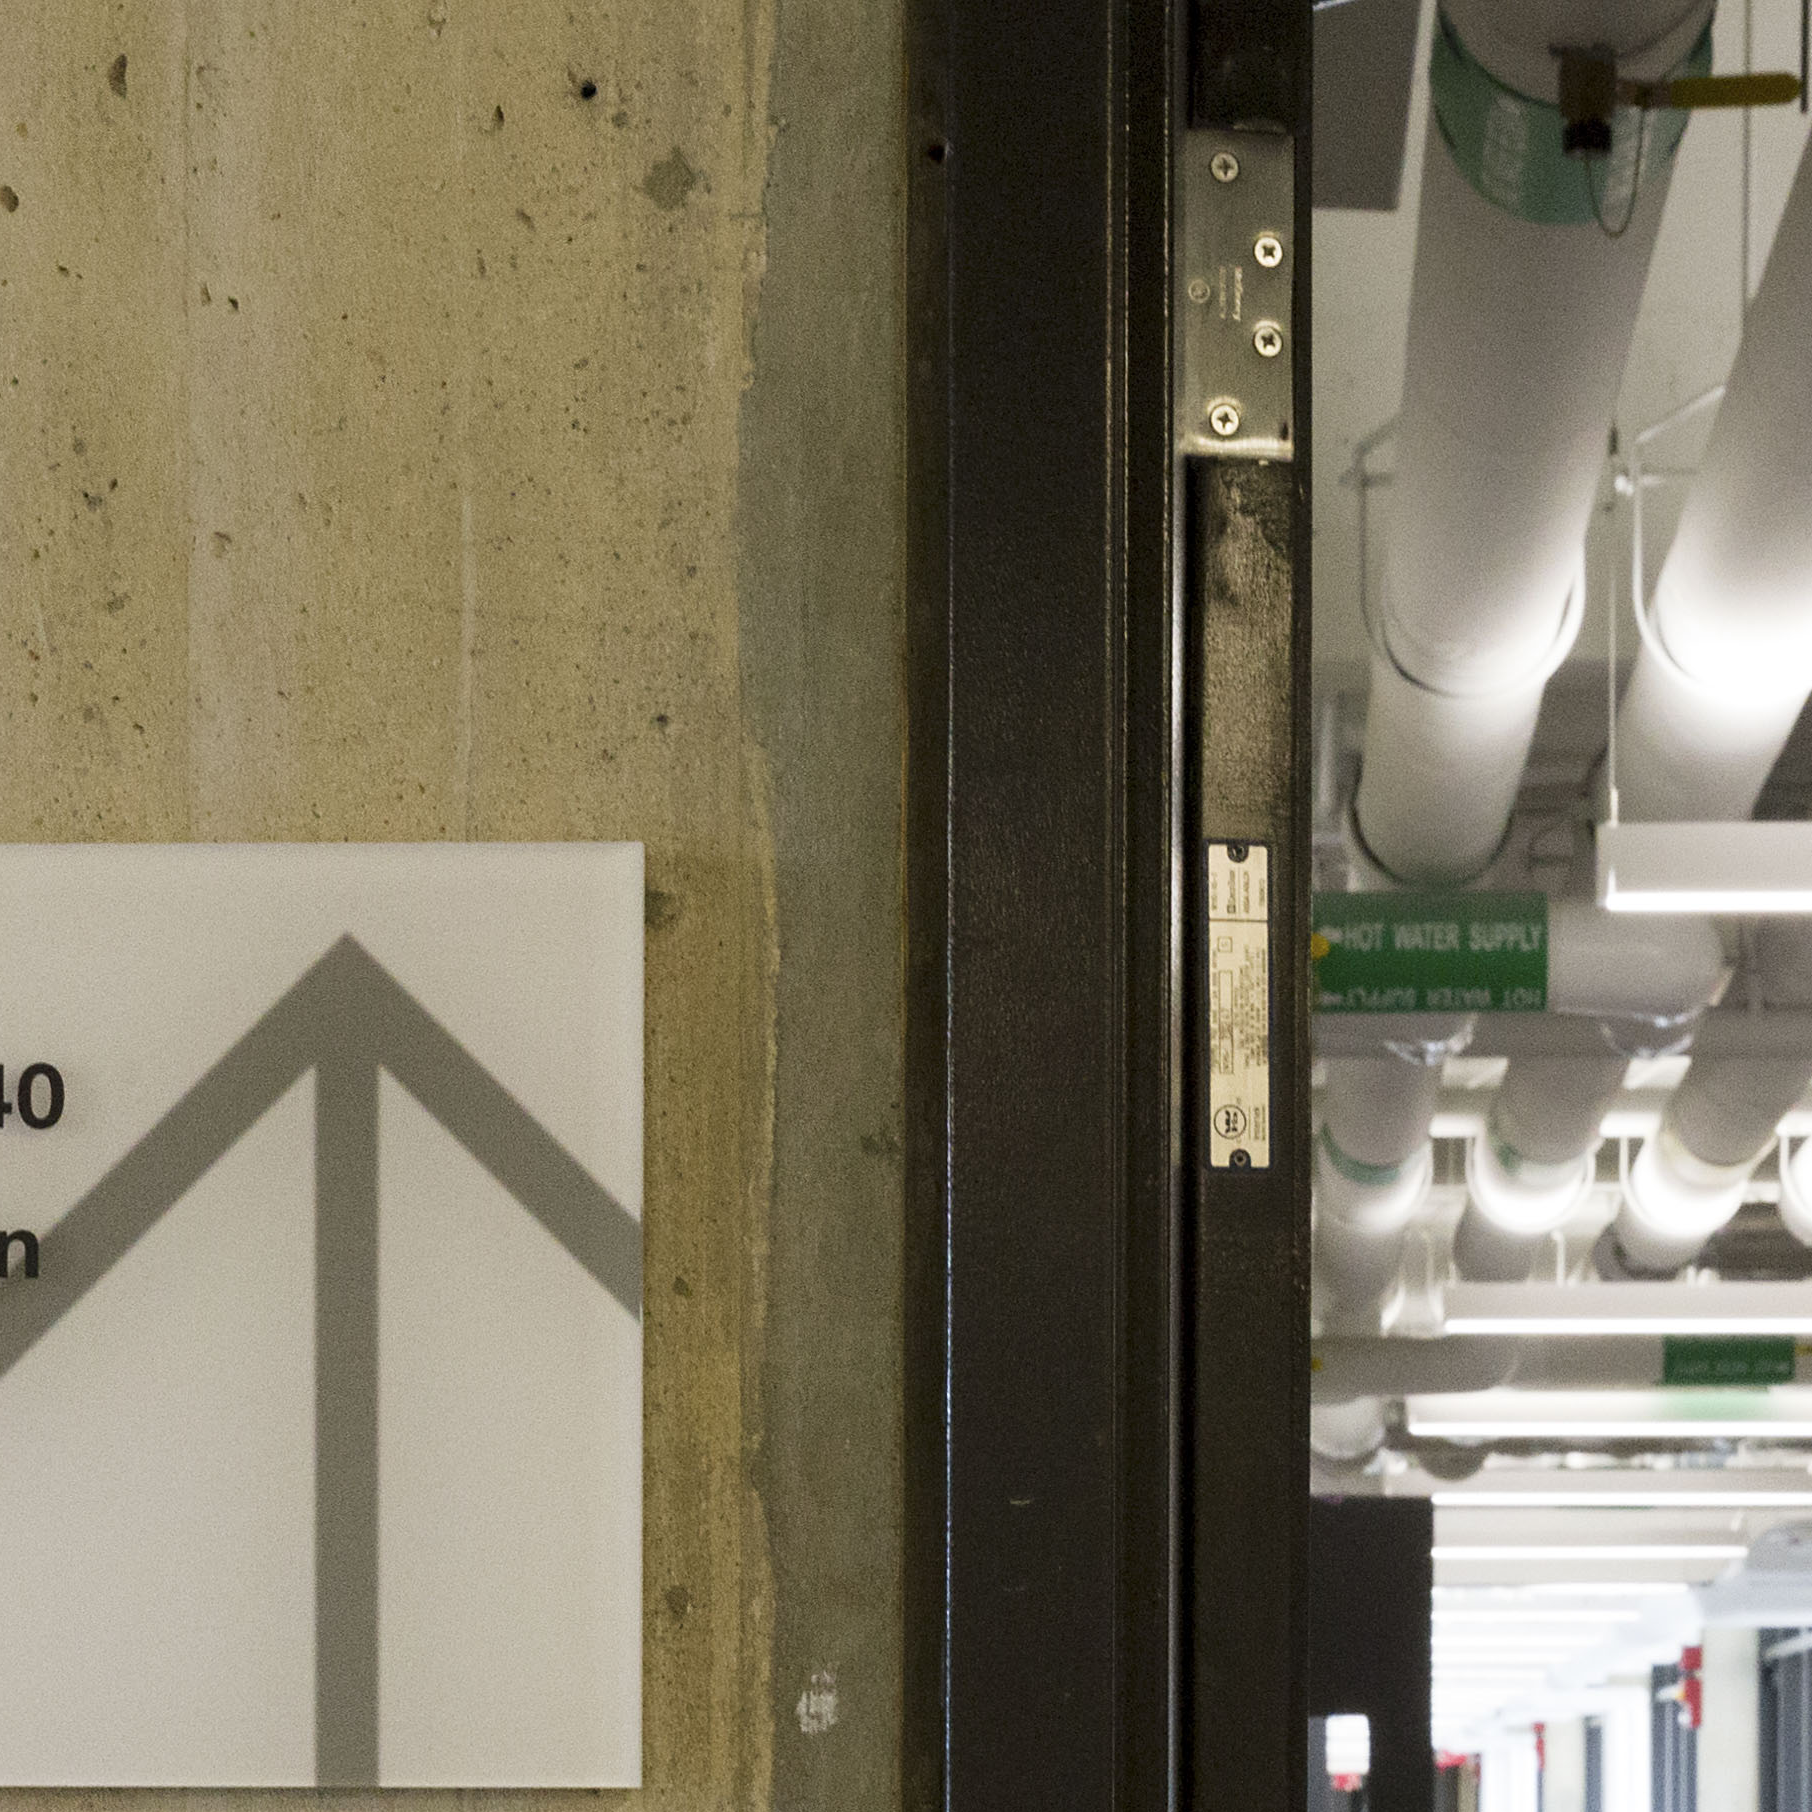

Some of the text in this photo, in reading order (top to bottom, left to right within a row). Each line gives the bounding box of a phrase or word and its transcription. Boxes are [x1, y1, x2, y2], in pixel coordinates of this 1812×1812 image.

[1344, 922, 1542, 951] HOT WATER SUPPLY
